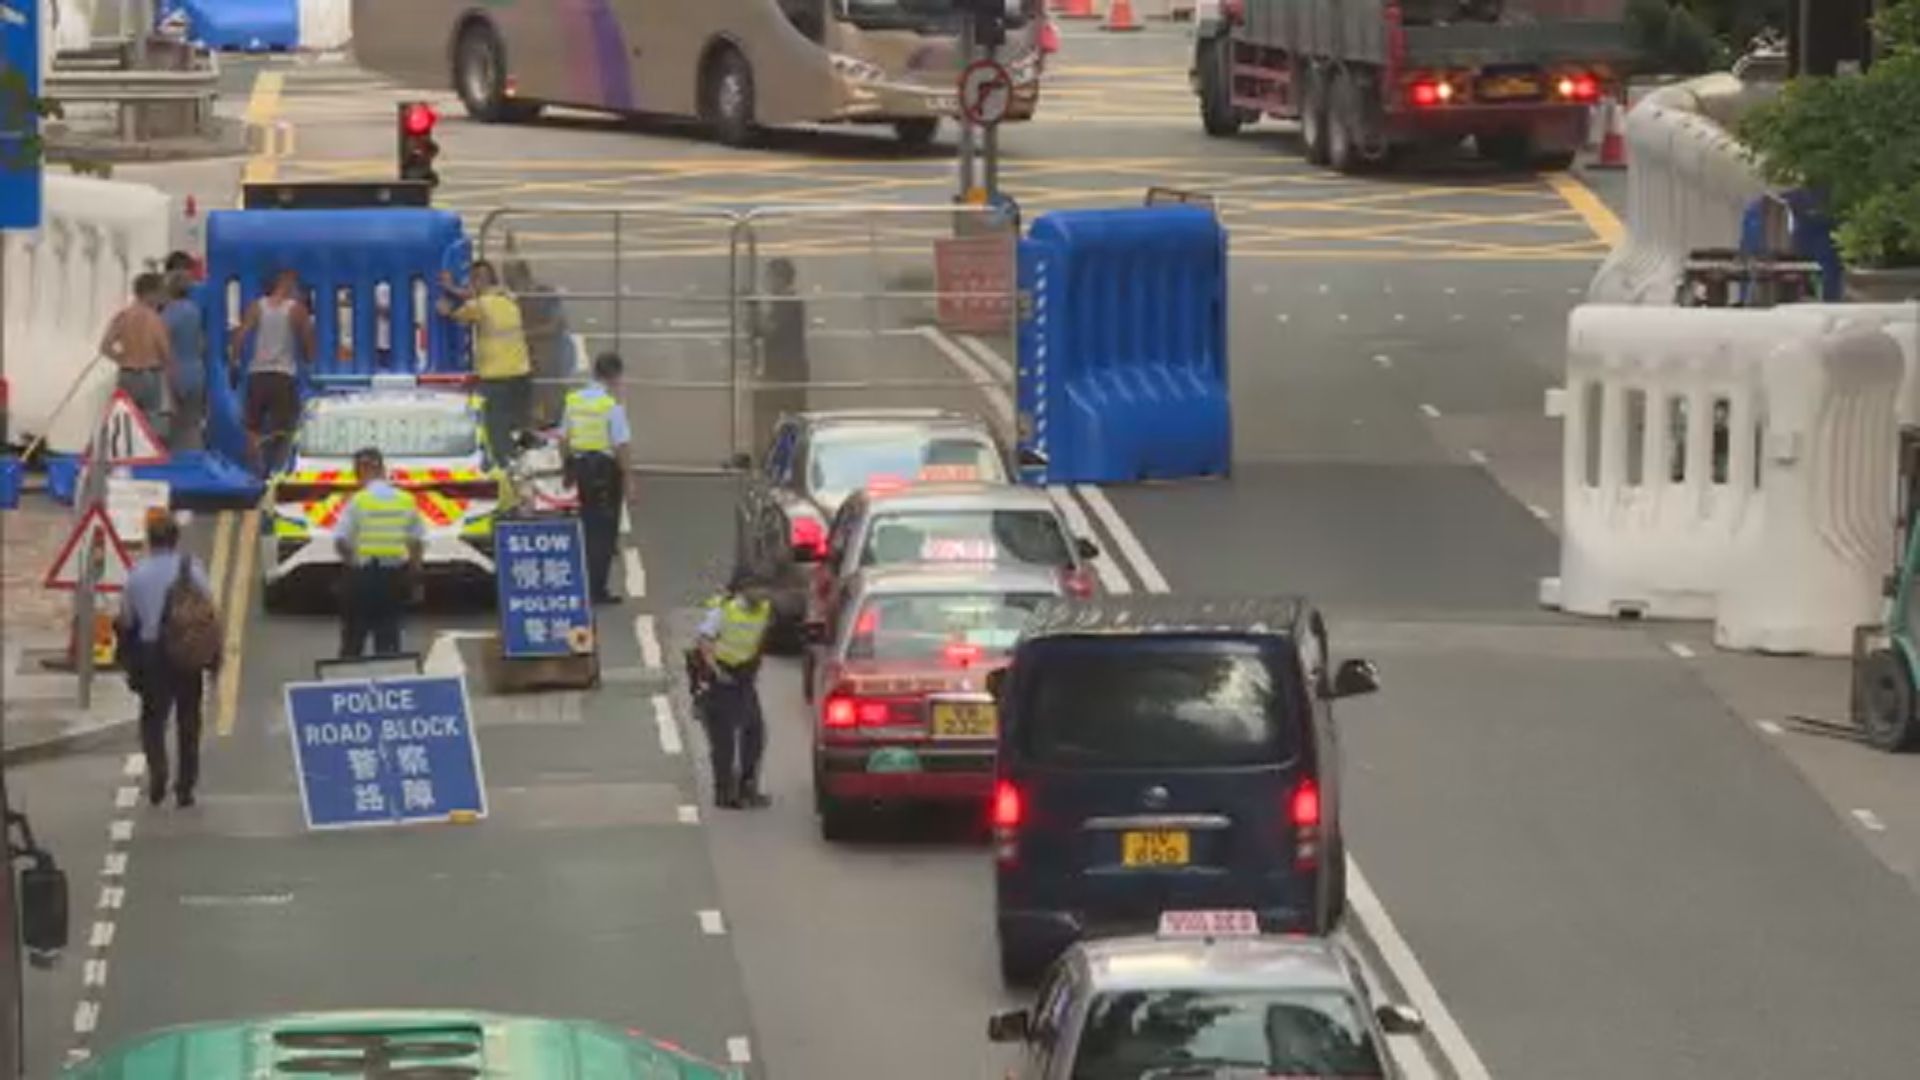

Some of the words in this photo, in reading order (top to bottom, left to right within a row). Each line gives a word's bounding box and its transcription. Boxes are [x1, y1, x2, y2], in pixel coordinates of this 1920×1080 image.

[508, 534, 571, 553] SLOW
[508, 595, 579, 612] POLICE
[331, 689, 417, 715] POLICE
[303, 721, 373, 747] ROAD
[380, 713, 461, 742] BLOCK
[347, 744, 431, 781] 警察
[353, 778, 436, 812] 路障
